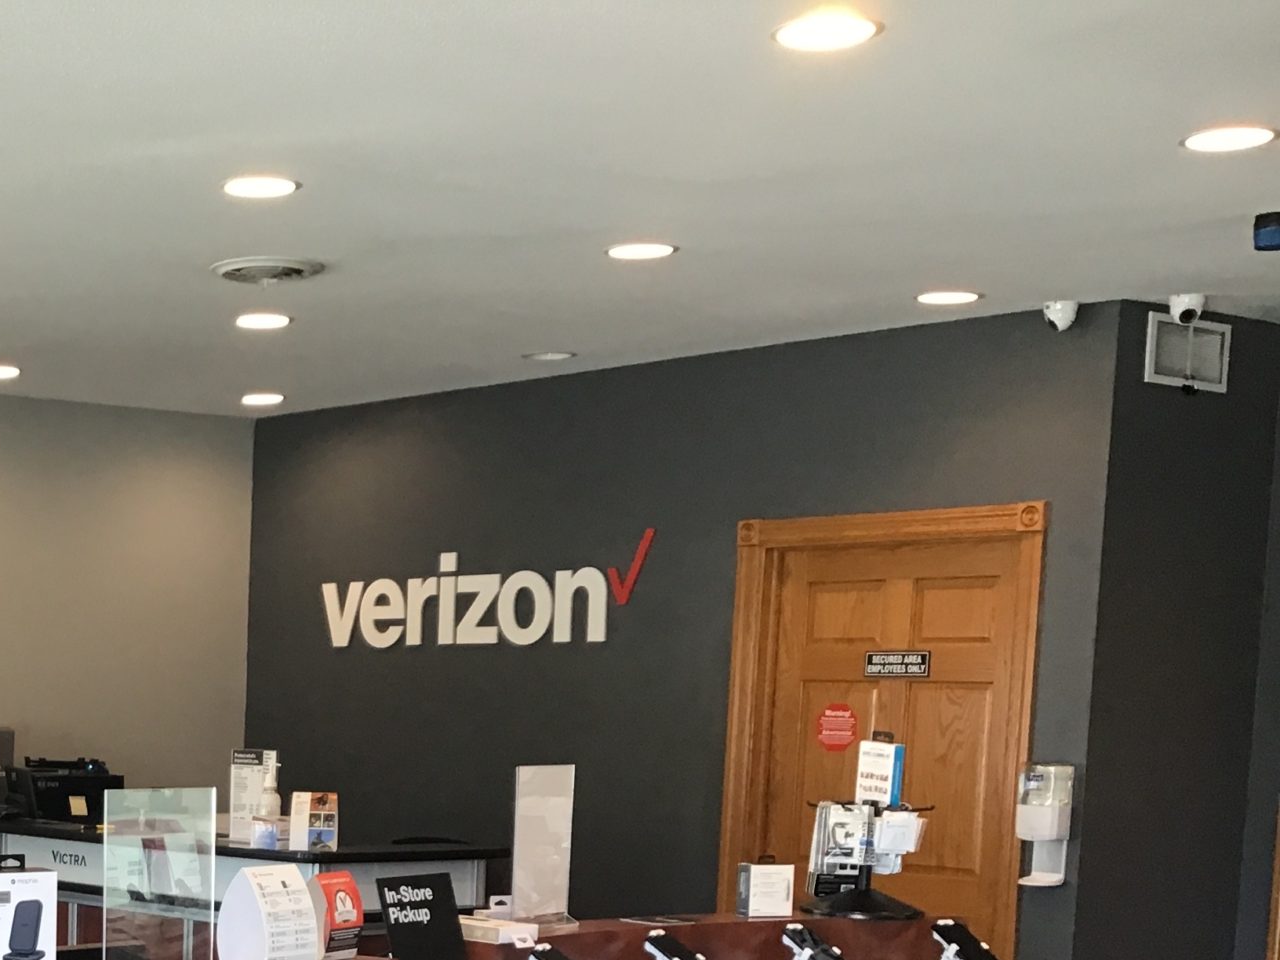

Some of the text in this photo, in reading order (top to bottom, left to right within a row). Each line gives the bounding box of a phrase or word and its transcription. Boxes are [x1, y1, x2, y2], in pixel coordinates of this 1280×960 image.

[322, 552, 607, 648] verizon
[872, 655, 922, 664] SECURED AREA
[867, 665, 925, 673] EMPLOYEES ONLY
[52, 850, 87, 867] VICTRA
[385, 885, 434, 904] In-Store
[389, 906, 431, 924] Pickup
